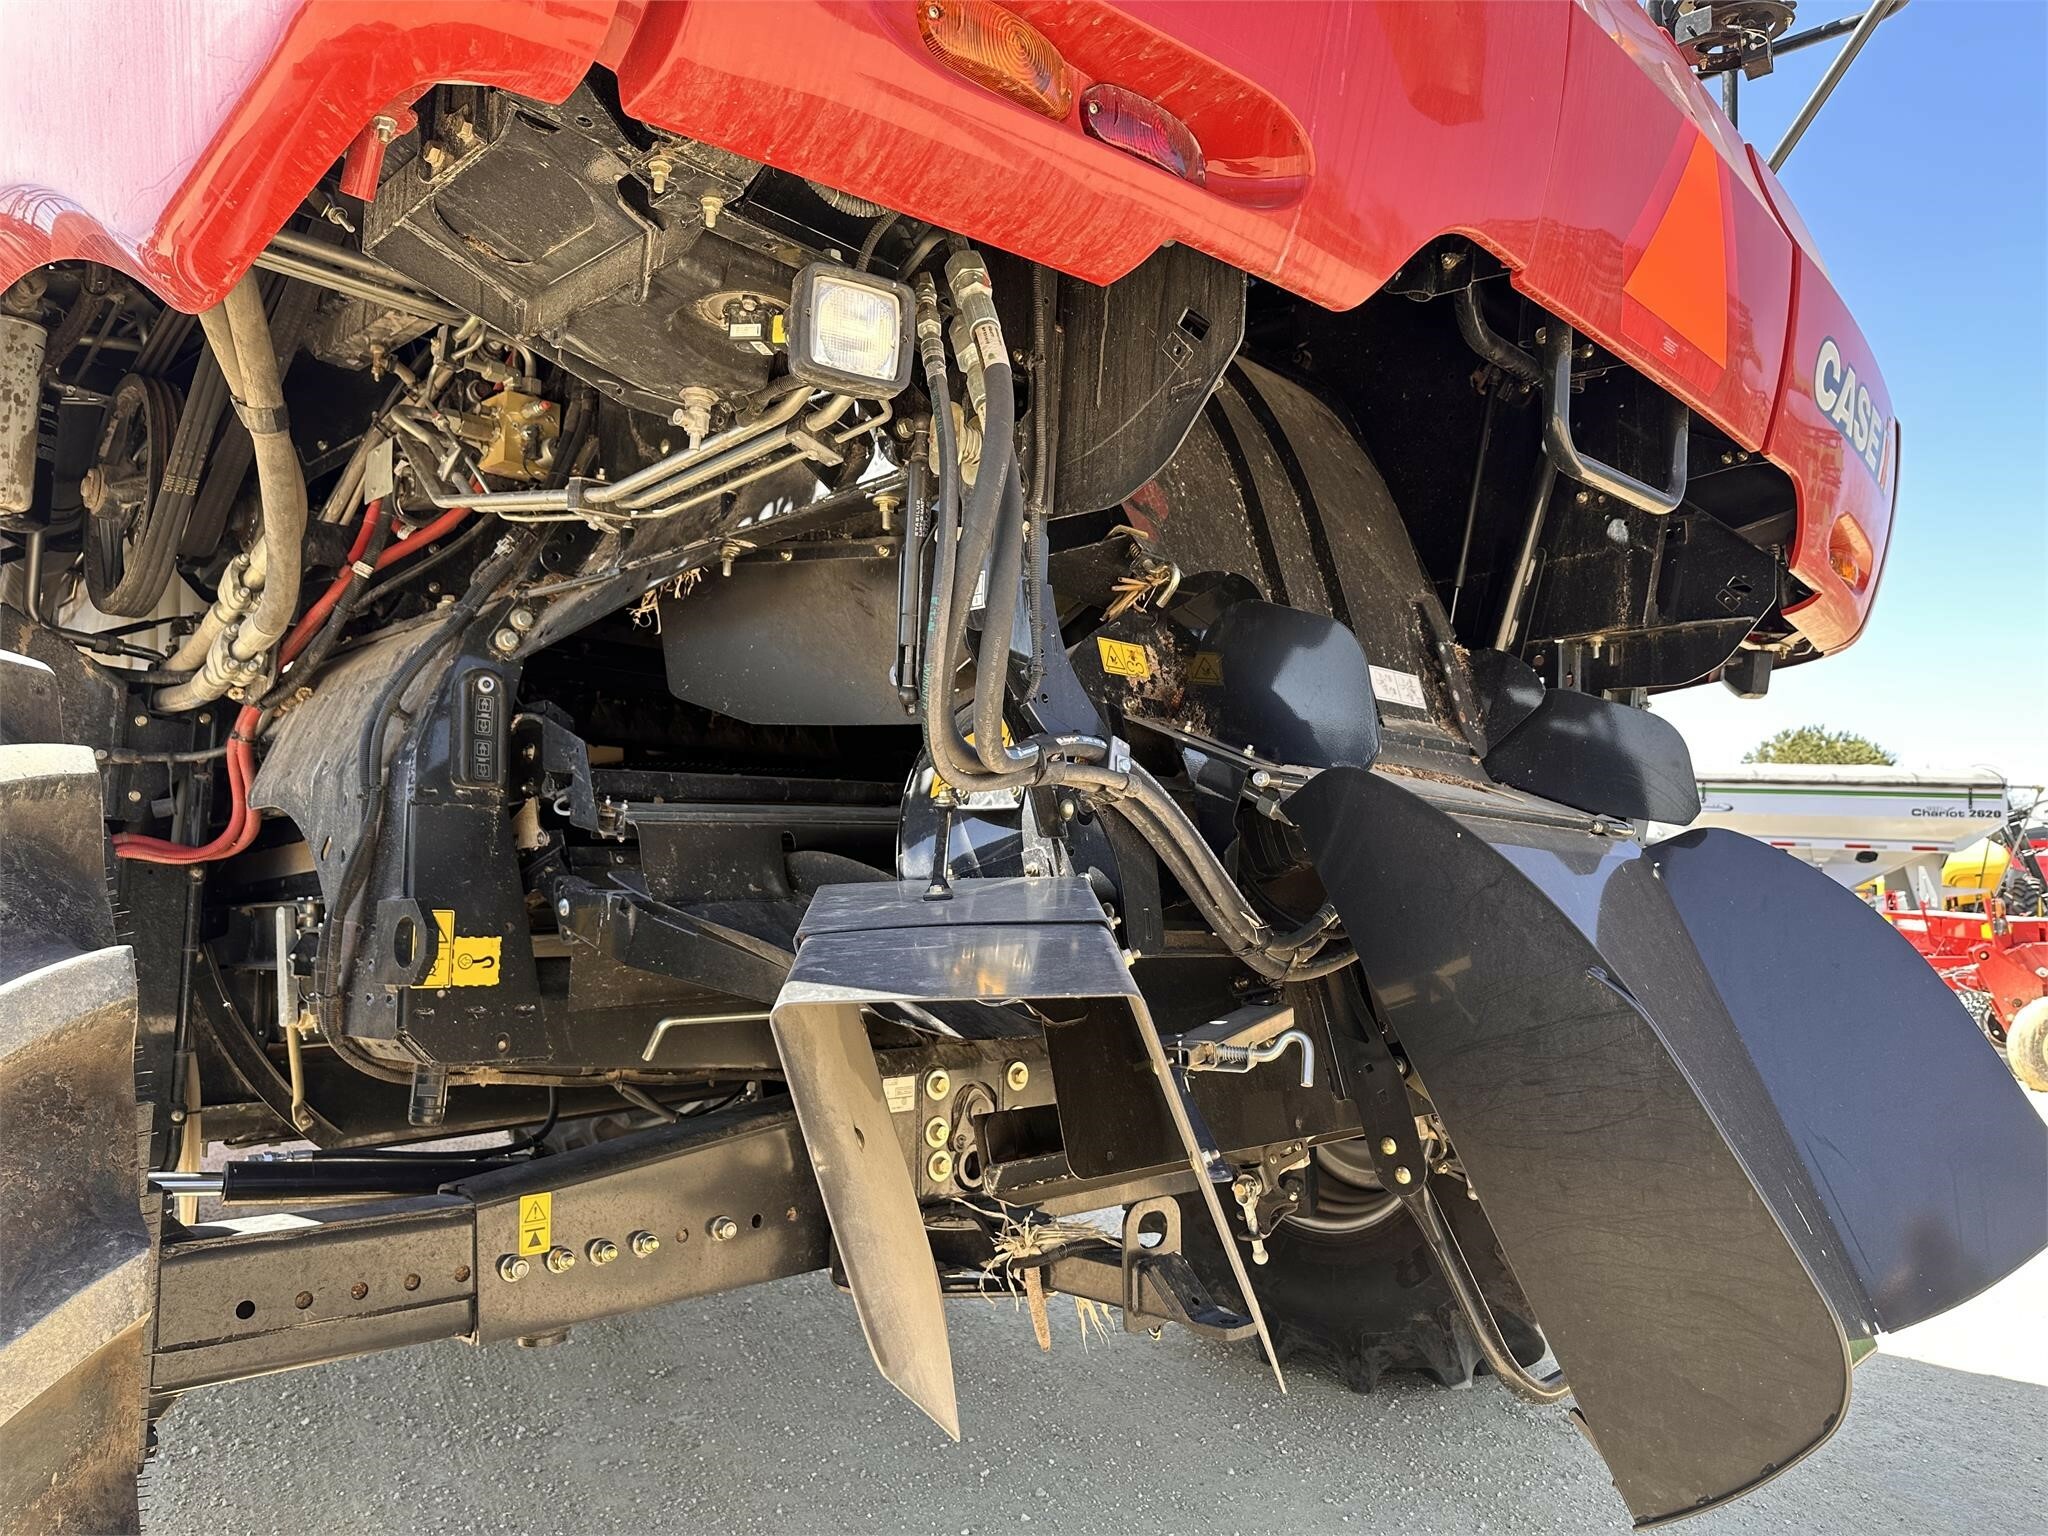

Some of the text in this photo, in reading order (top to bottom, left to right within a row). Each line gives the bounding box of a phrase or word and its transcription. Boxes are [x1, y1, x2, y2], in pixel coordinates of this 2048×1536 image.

[1814, 340, 1882, 473] CASE
[921, 663, 931, 710] WINNER
[1911, 808, 1965, 818] Chariot
